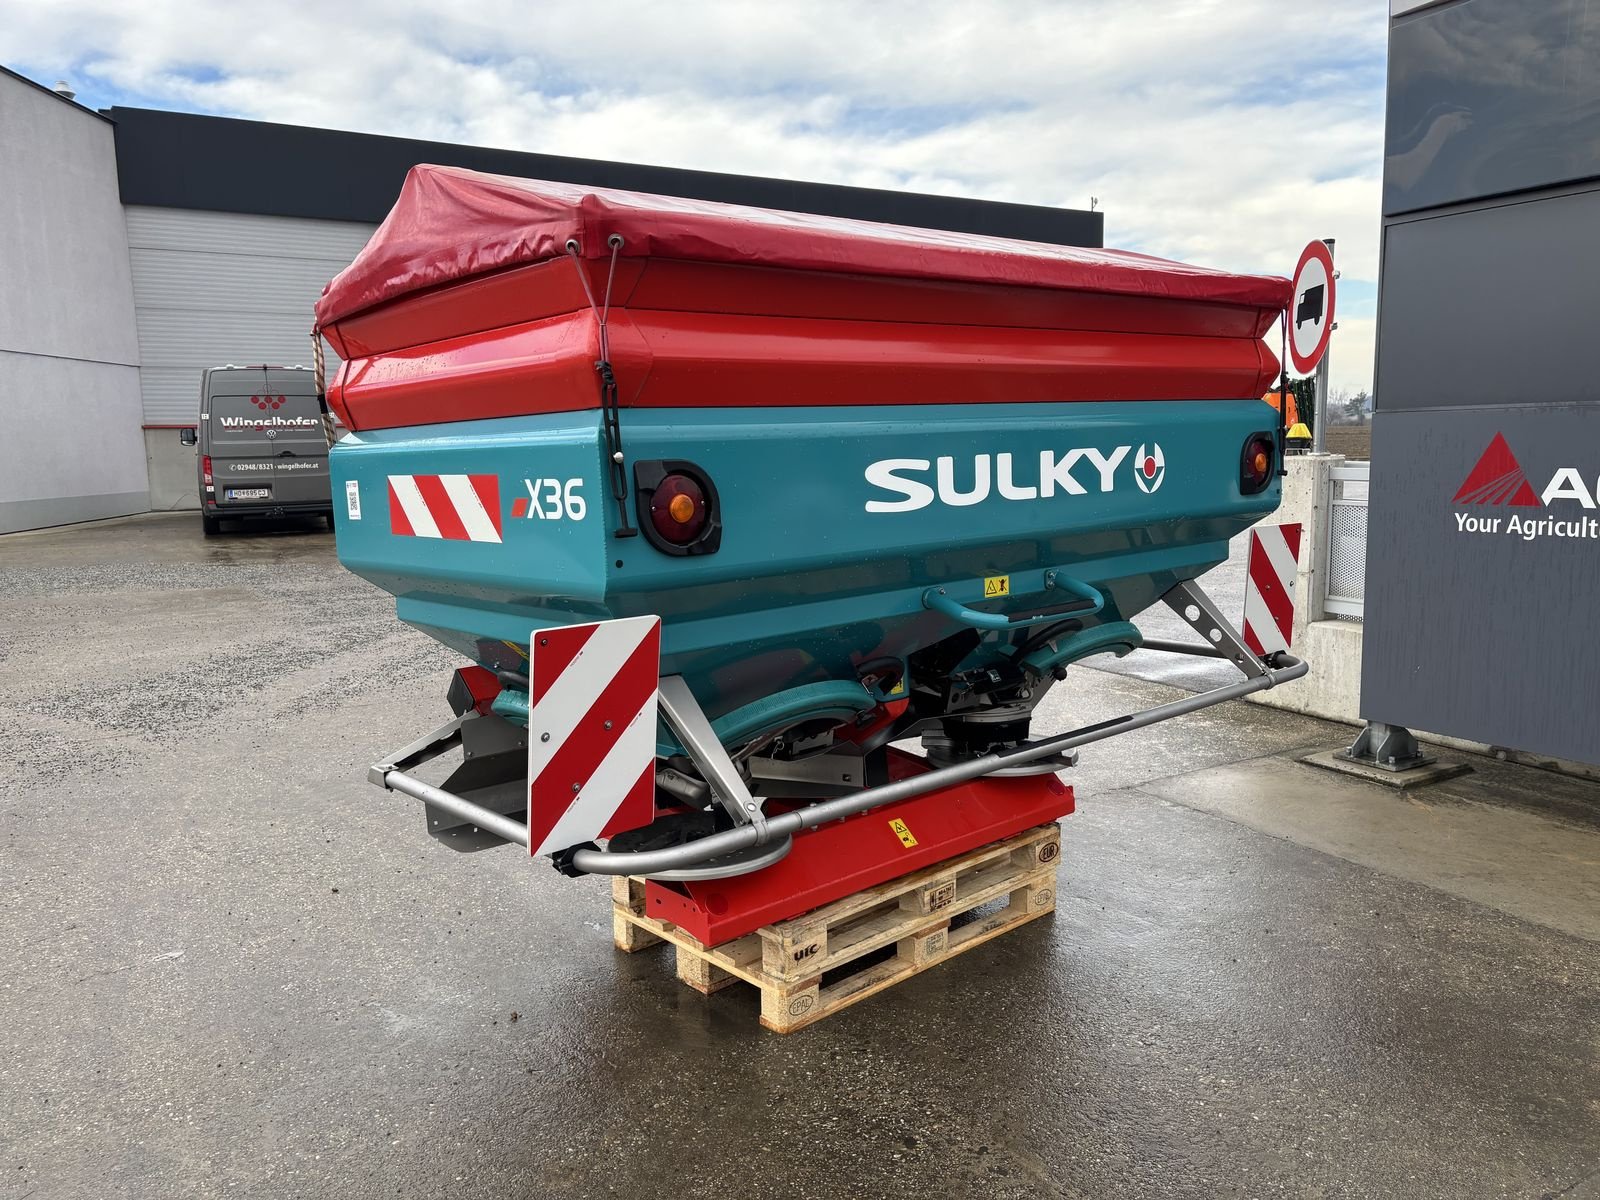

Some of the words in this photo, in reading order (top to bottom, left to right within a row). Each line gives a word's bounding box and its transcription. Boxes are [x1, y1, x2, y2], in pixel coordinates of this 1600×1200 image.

[220, 416, 319, 432] Wingelhofer
[237, 463, 274, 471] 02948/8321
[277, 462, 319, 471] wingelhofer.at
[865, 445, 1132, 513] SULKY
[1541, 467, 1600, 509] A
[524, 478, 586, 521] X36
[1454, 512, 1501, 534] Your
[1506, 514, 1600, 541] Agricult
[1042, 843, 1056, 860] EUR
[792, 998, 809, 1014] EPAL
